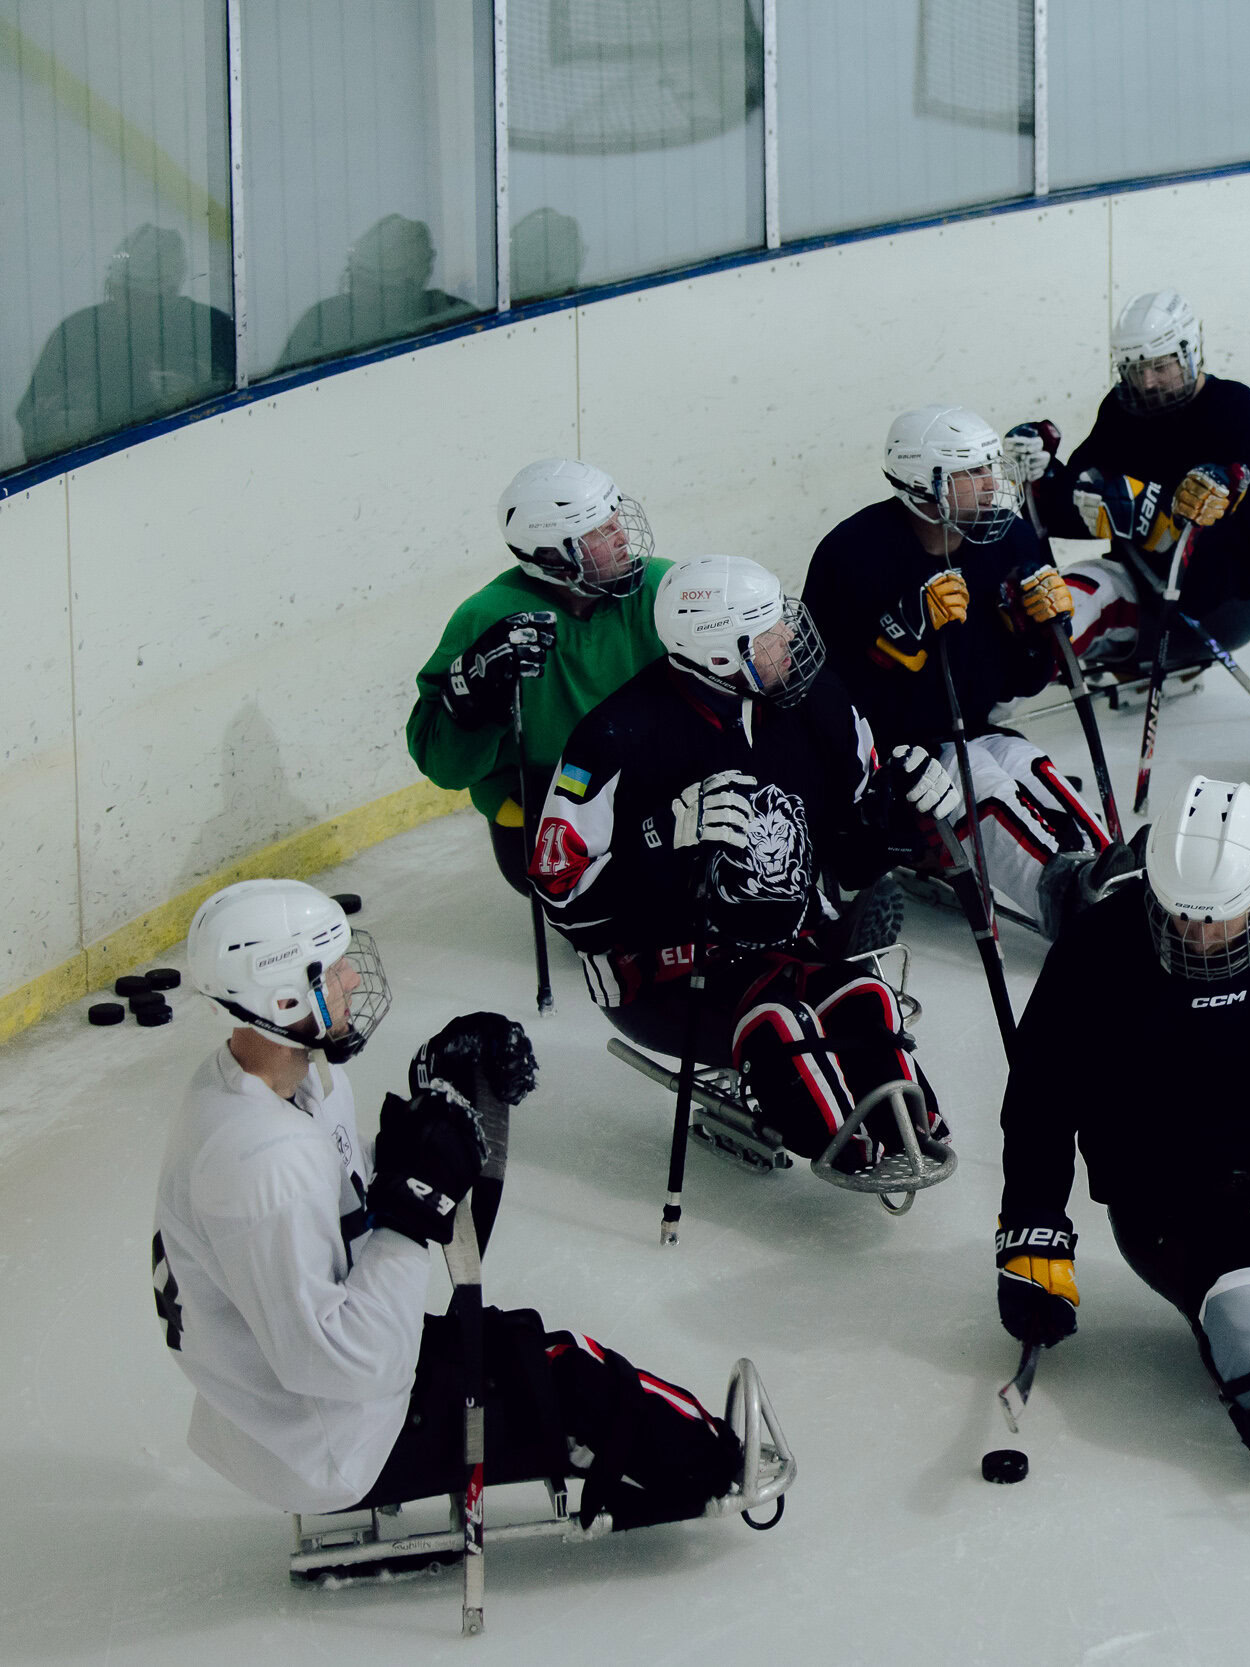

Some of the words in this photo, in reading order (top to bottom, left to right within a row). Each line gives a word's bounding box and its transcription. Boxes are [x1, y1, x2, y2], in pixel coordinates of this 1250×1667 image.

[681, 590, 713, 601] ROXY
[696, 618, 730, 632] BAUER
[708, 674, 737, 691] BAUER
[539, 823, 571, 876] 11
[1174, 901, 1215, 912] BAUER
[258, 947, 299, 969] BAUER
[1191, 990, 1248, 1009] CCM
[996, 1227, 1071, 1254] AUER
